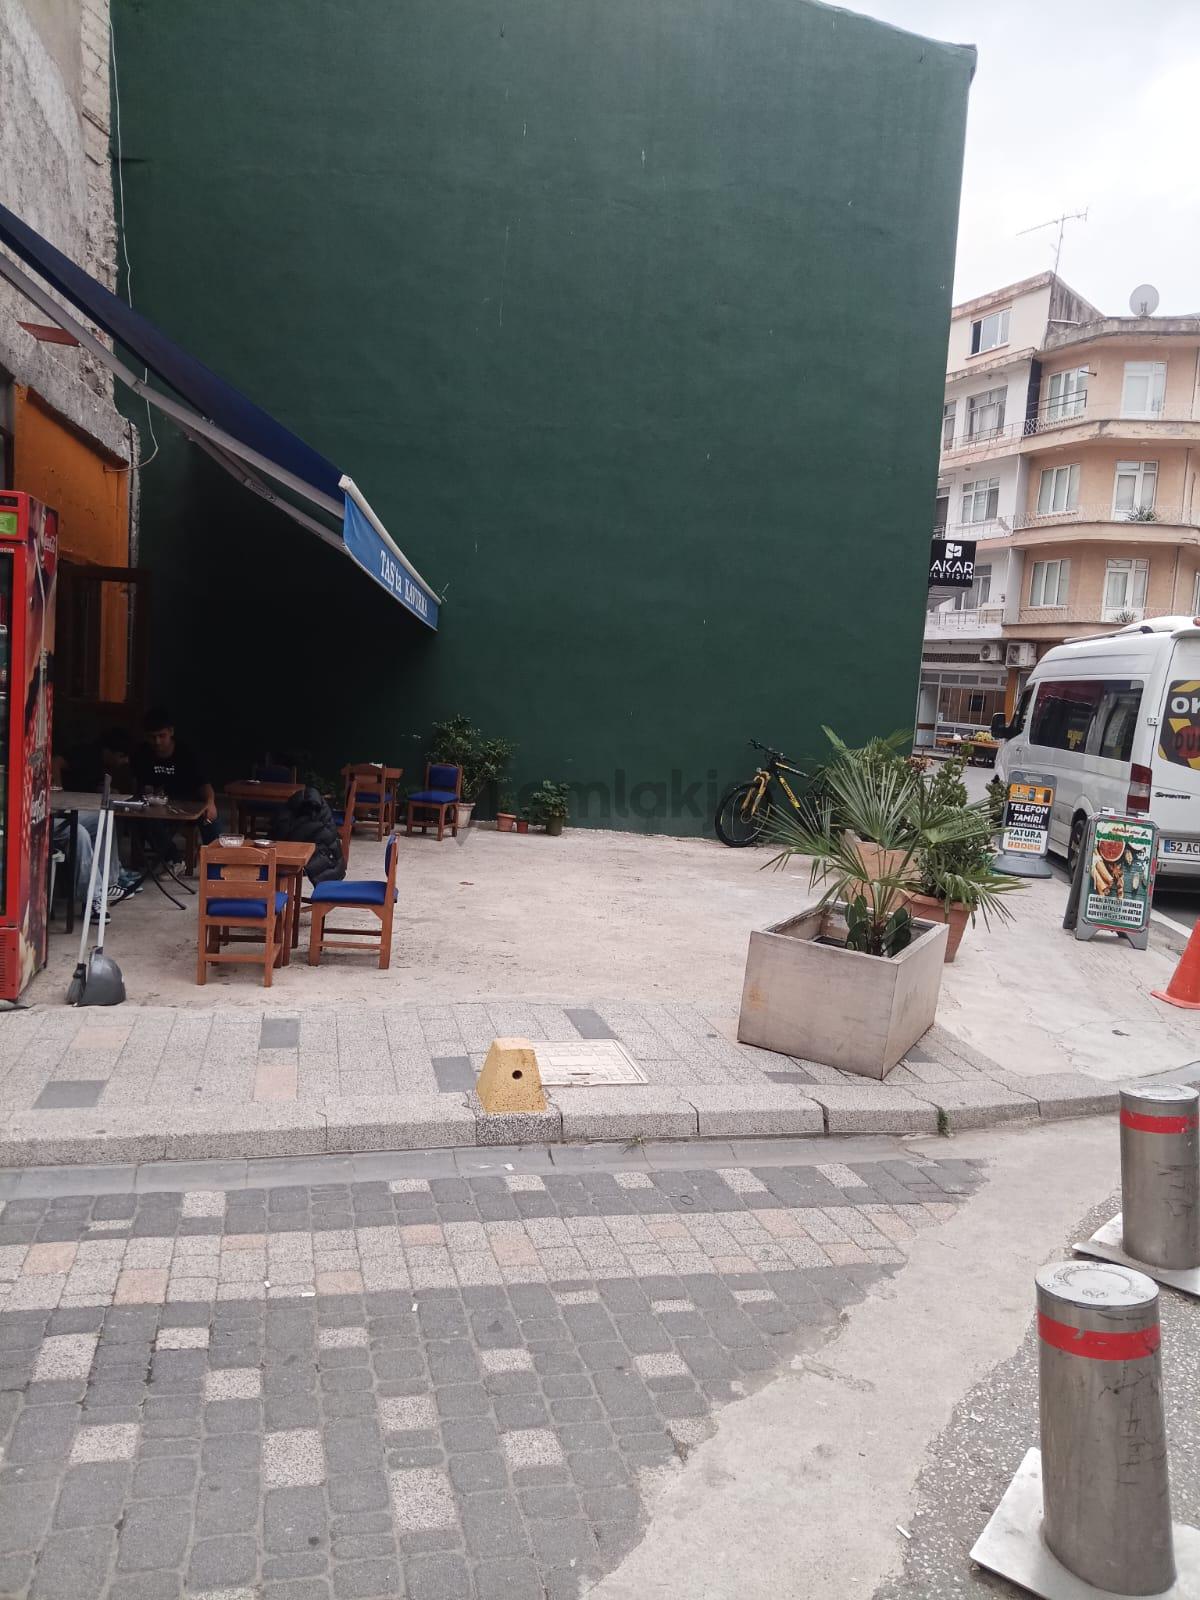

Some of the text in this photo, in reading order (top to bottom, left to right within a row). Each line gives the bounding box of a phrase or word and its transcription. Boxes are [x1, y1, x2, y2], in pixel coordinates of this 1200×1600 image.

[930, 559, 974, 574] AKAR
[1010, 803, 1049, 815] TELEFON
[1013, 813, 1044, 824] TAMİRİ
[1170, 841, 1200, 855] 52 AC
